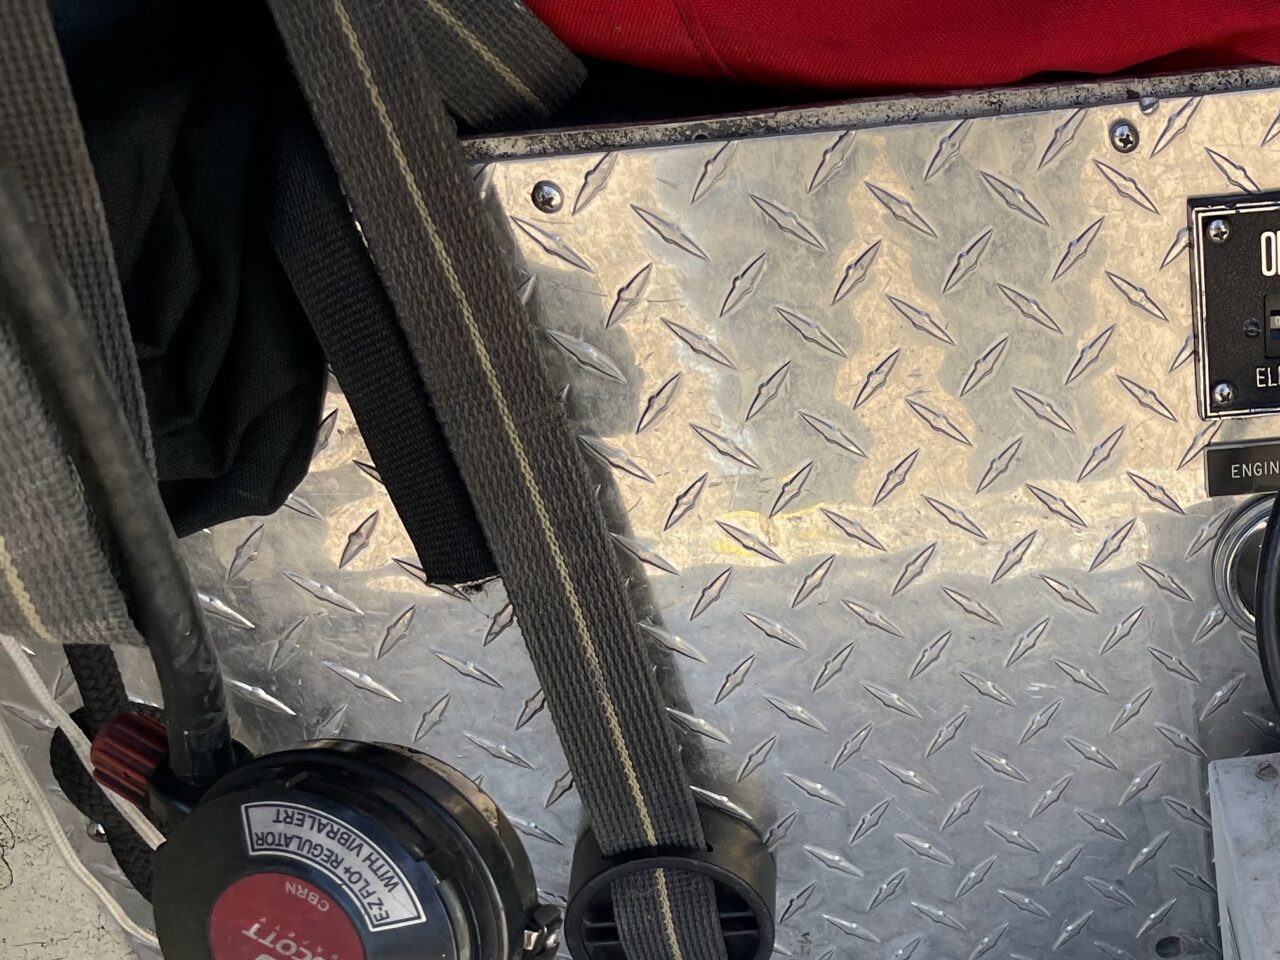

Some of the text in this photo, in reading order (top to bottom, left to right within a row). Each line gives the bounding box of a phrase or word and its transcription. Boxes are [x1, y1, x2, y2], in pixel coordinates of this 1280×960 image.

[255, 832, 389, 922] E-Z FLO+ REGULATOR
[272, 809, 400, 893] WITH VIBRALERT
[286, 882, 329, 912] CBRN
